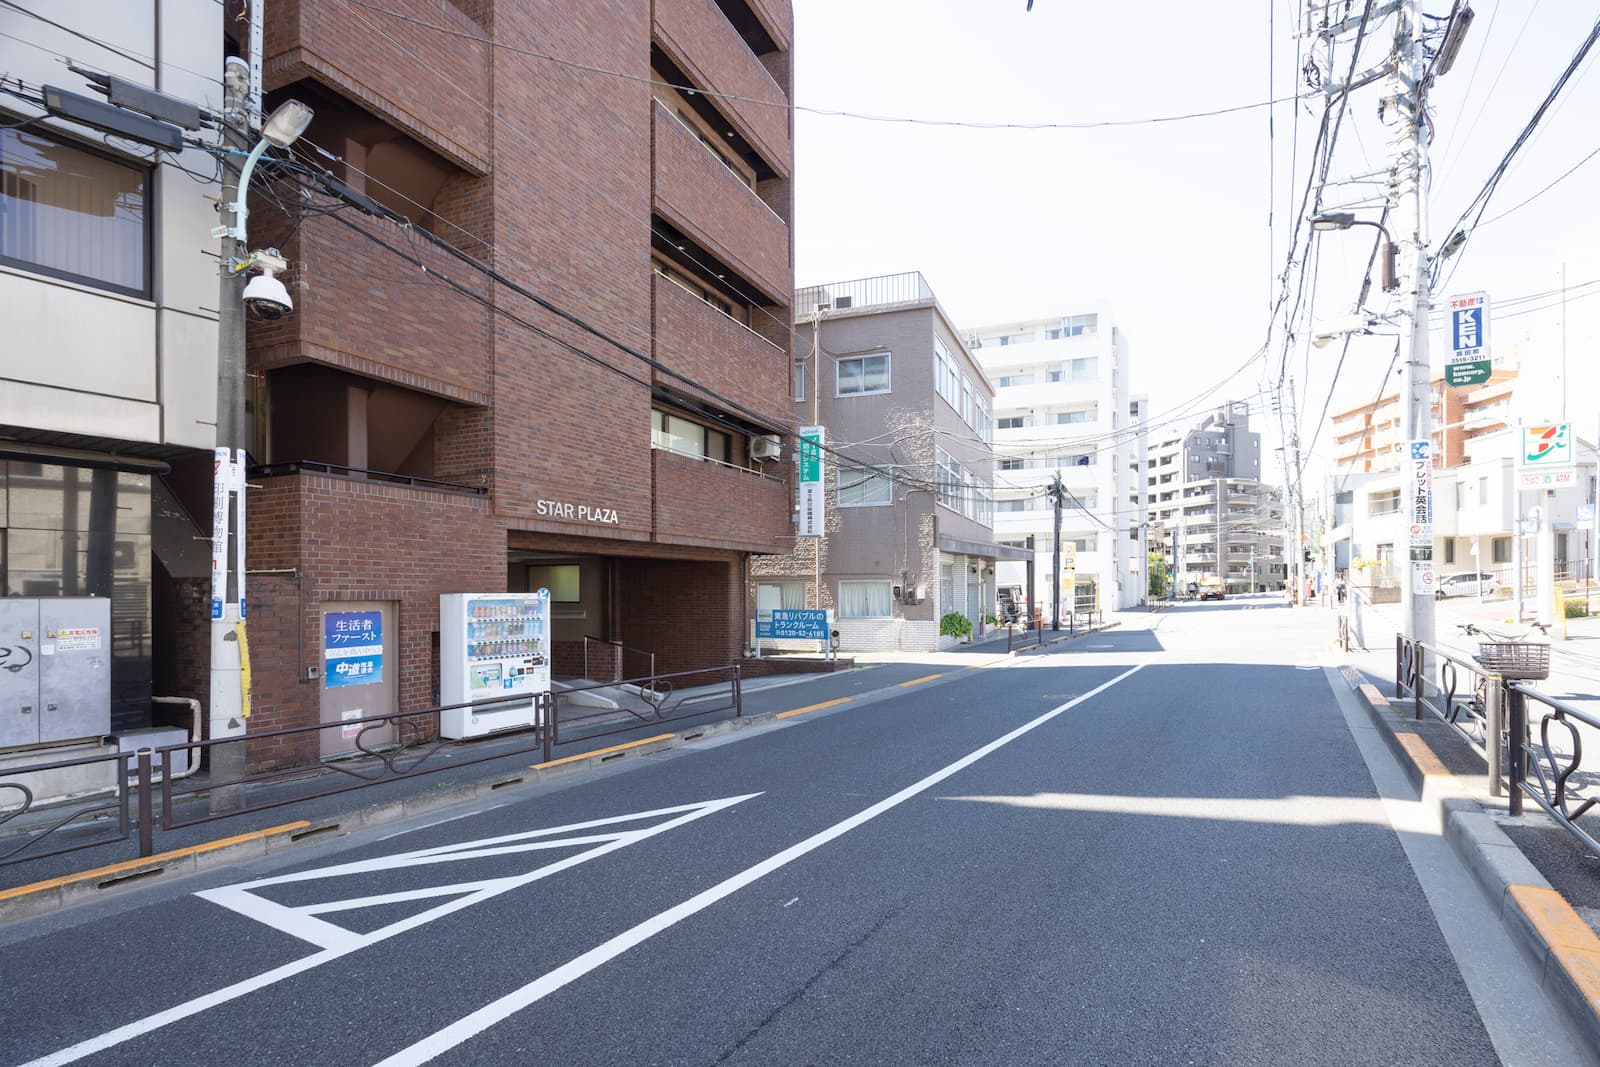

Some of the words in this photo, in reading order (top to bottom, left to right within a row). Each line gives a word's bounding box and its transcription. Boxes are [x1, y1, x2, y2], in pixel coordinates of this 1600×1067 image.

[1450, 297, 1484, 309] 不動産は
[1458, 309, 1477, 350] KEN
[536, 499, 574, 518] STAR
[578, 505, 619, 524] PLAZA
[774, 612, 825, 621] 東急リバブルの
[335, 619, 373, 632] 生活者
[774, 621, 820, 629] トランクルーム
[332, 631, 376, 643] ファースト
